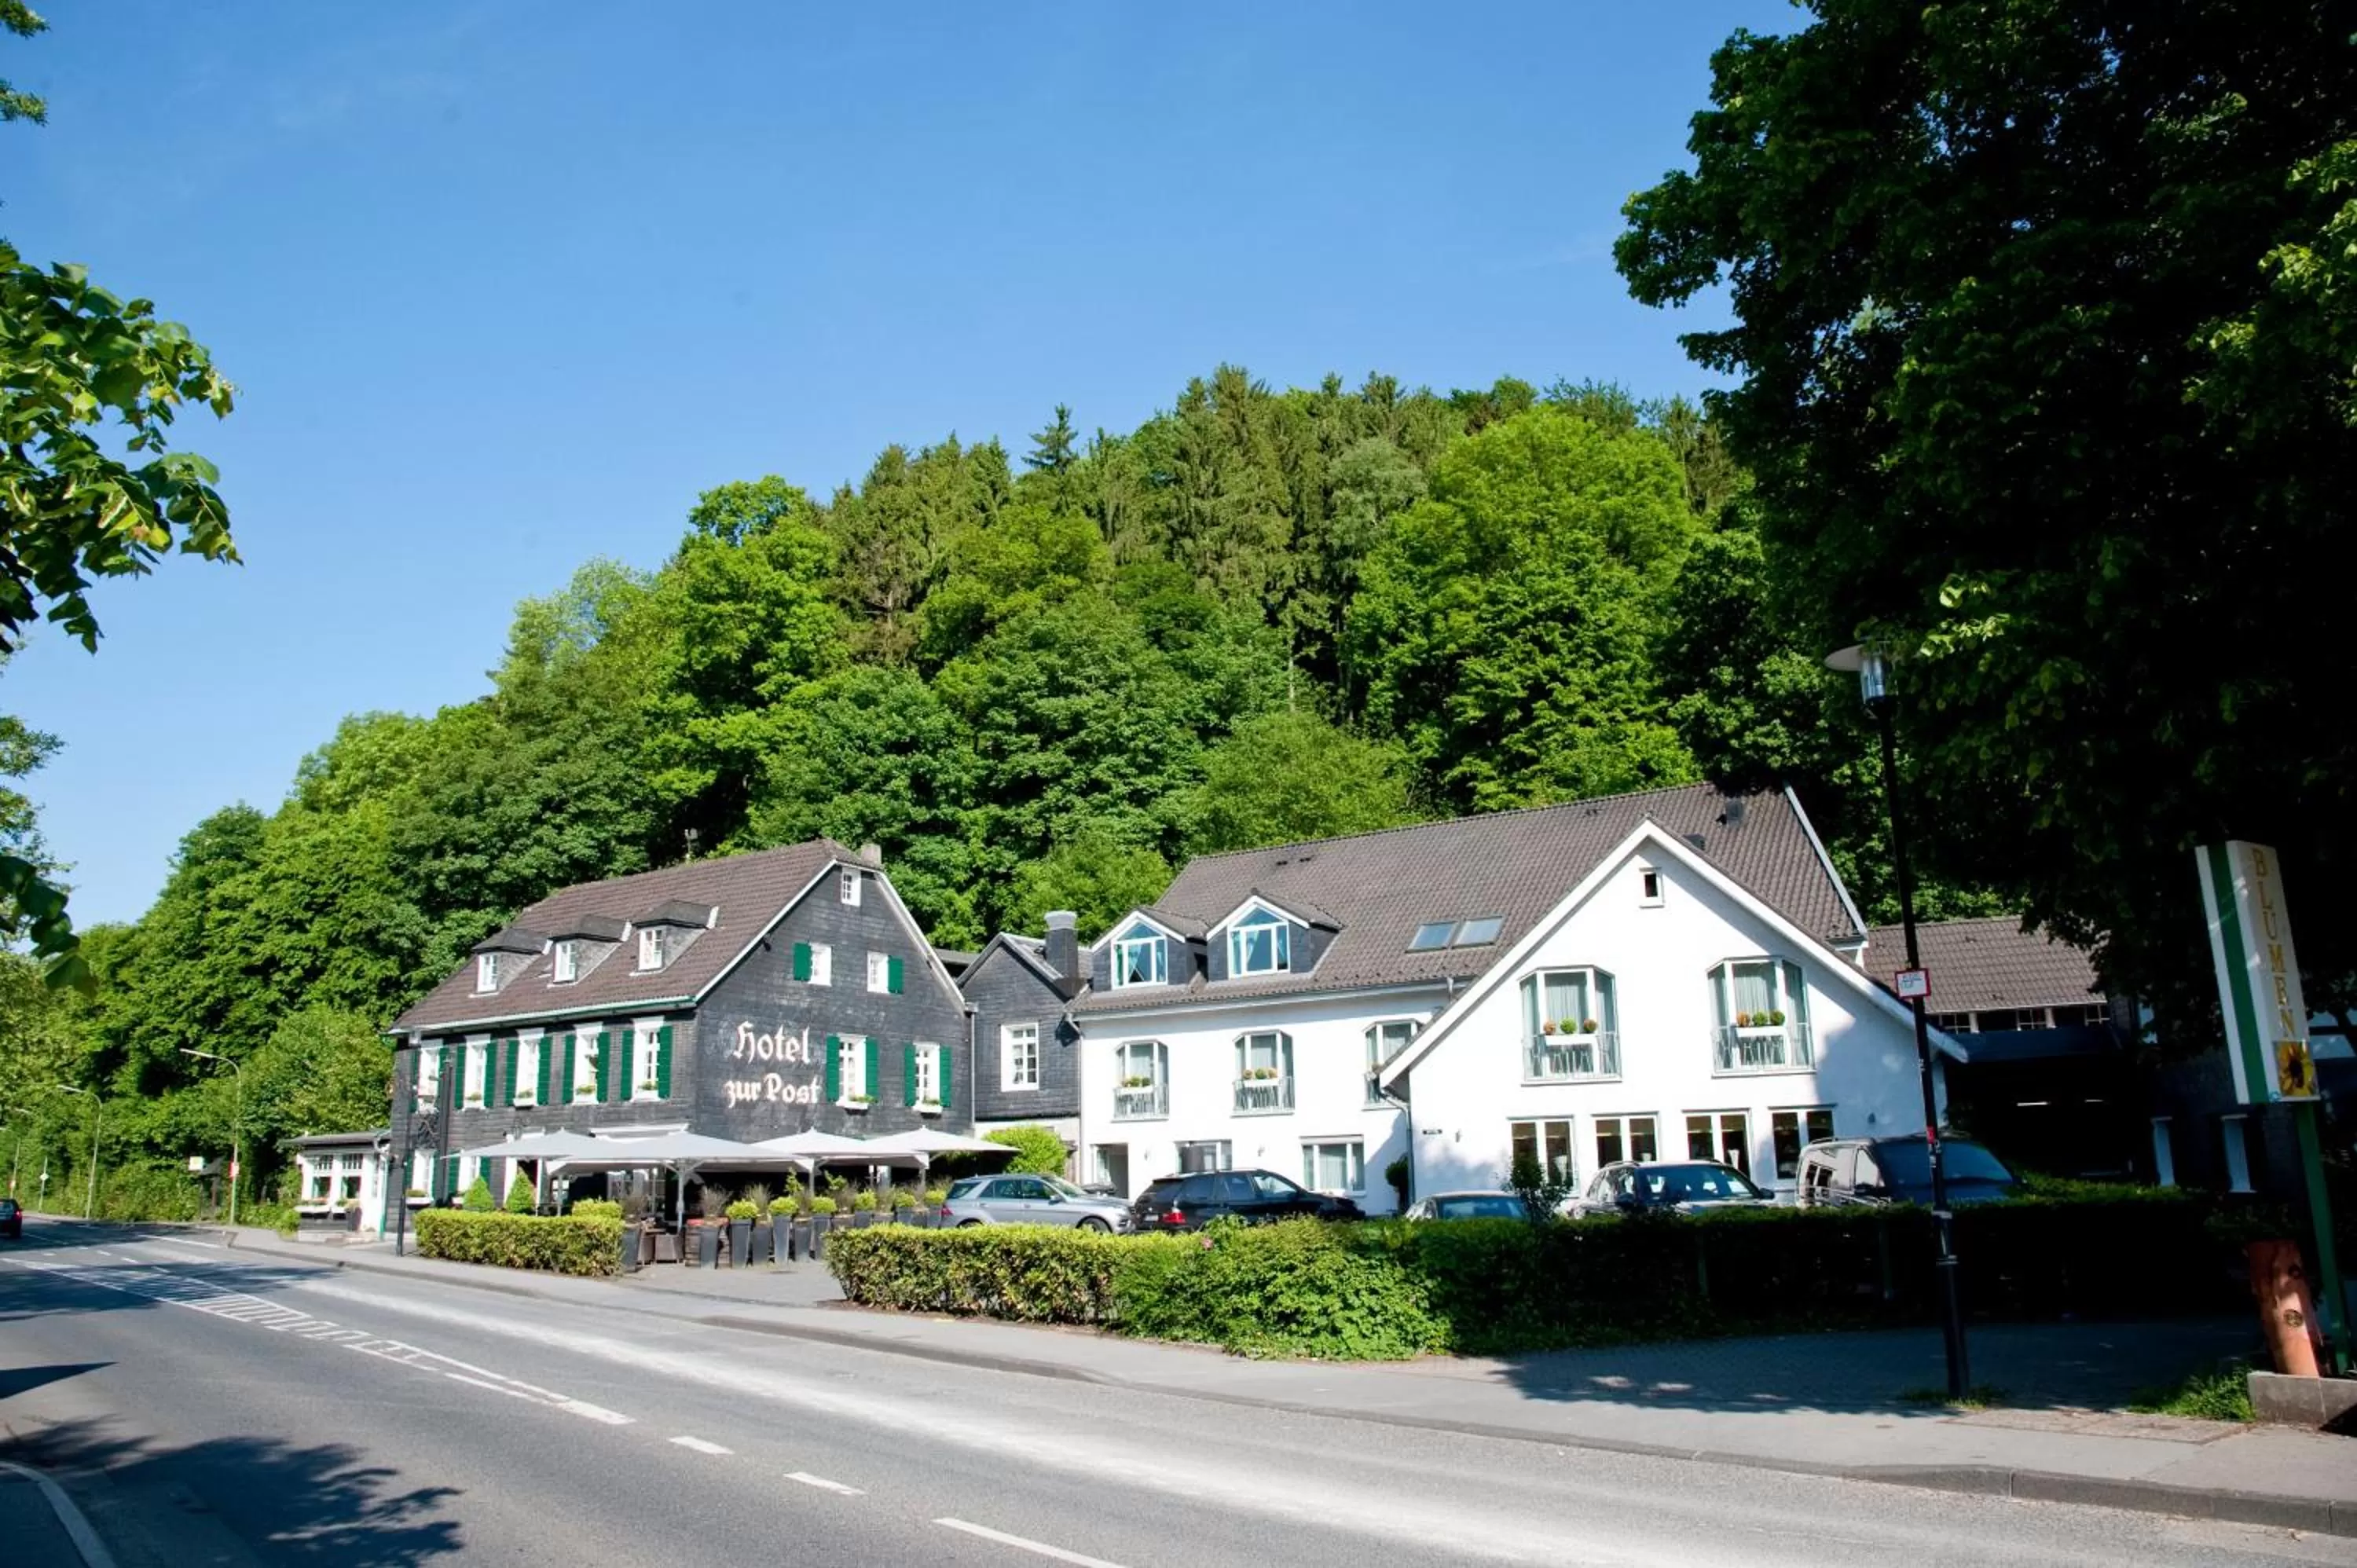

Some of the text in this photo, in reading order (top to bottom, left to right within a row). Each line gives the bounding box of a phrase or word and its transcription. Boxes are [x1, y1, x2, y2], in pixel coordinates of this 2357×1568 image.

[2252, 848, 2295, 1037] BLUMEN
[733, 1021, 810, 1064] Hotel
[724, 1073, 821, 1108] zur Post
